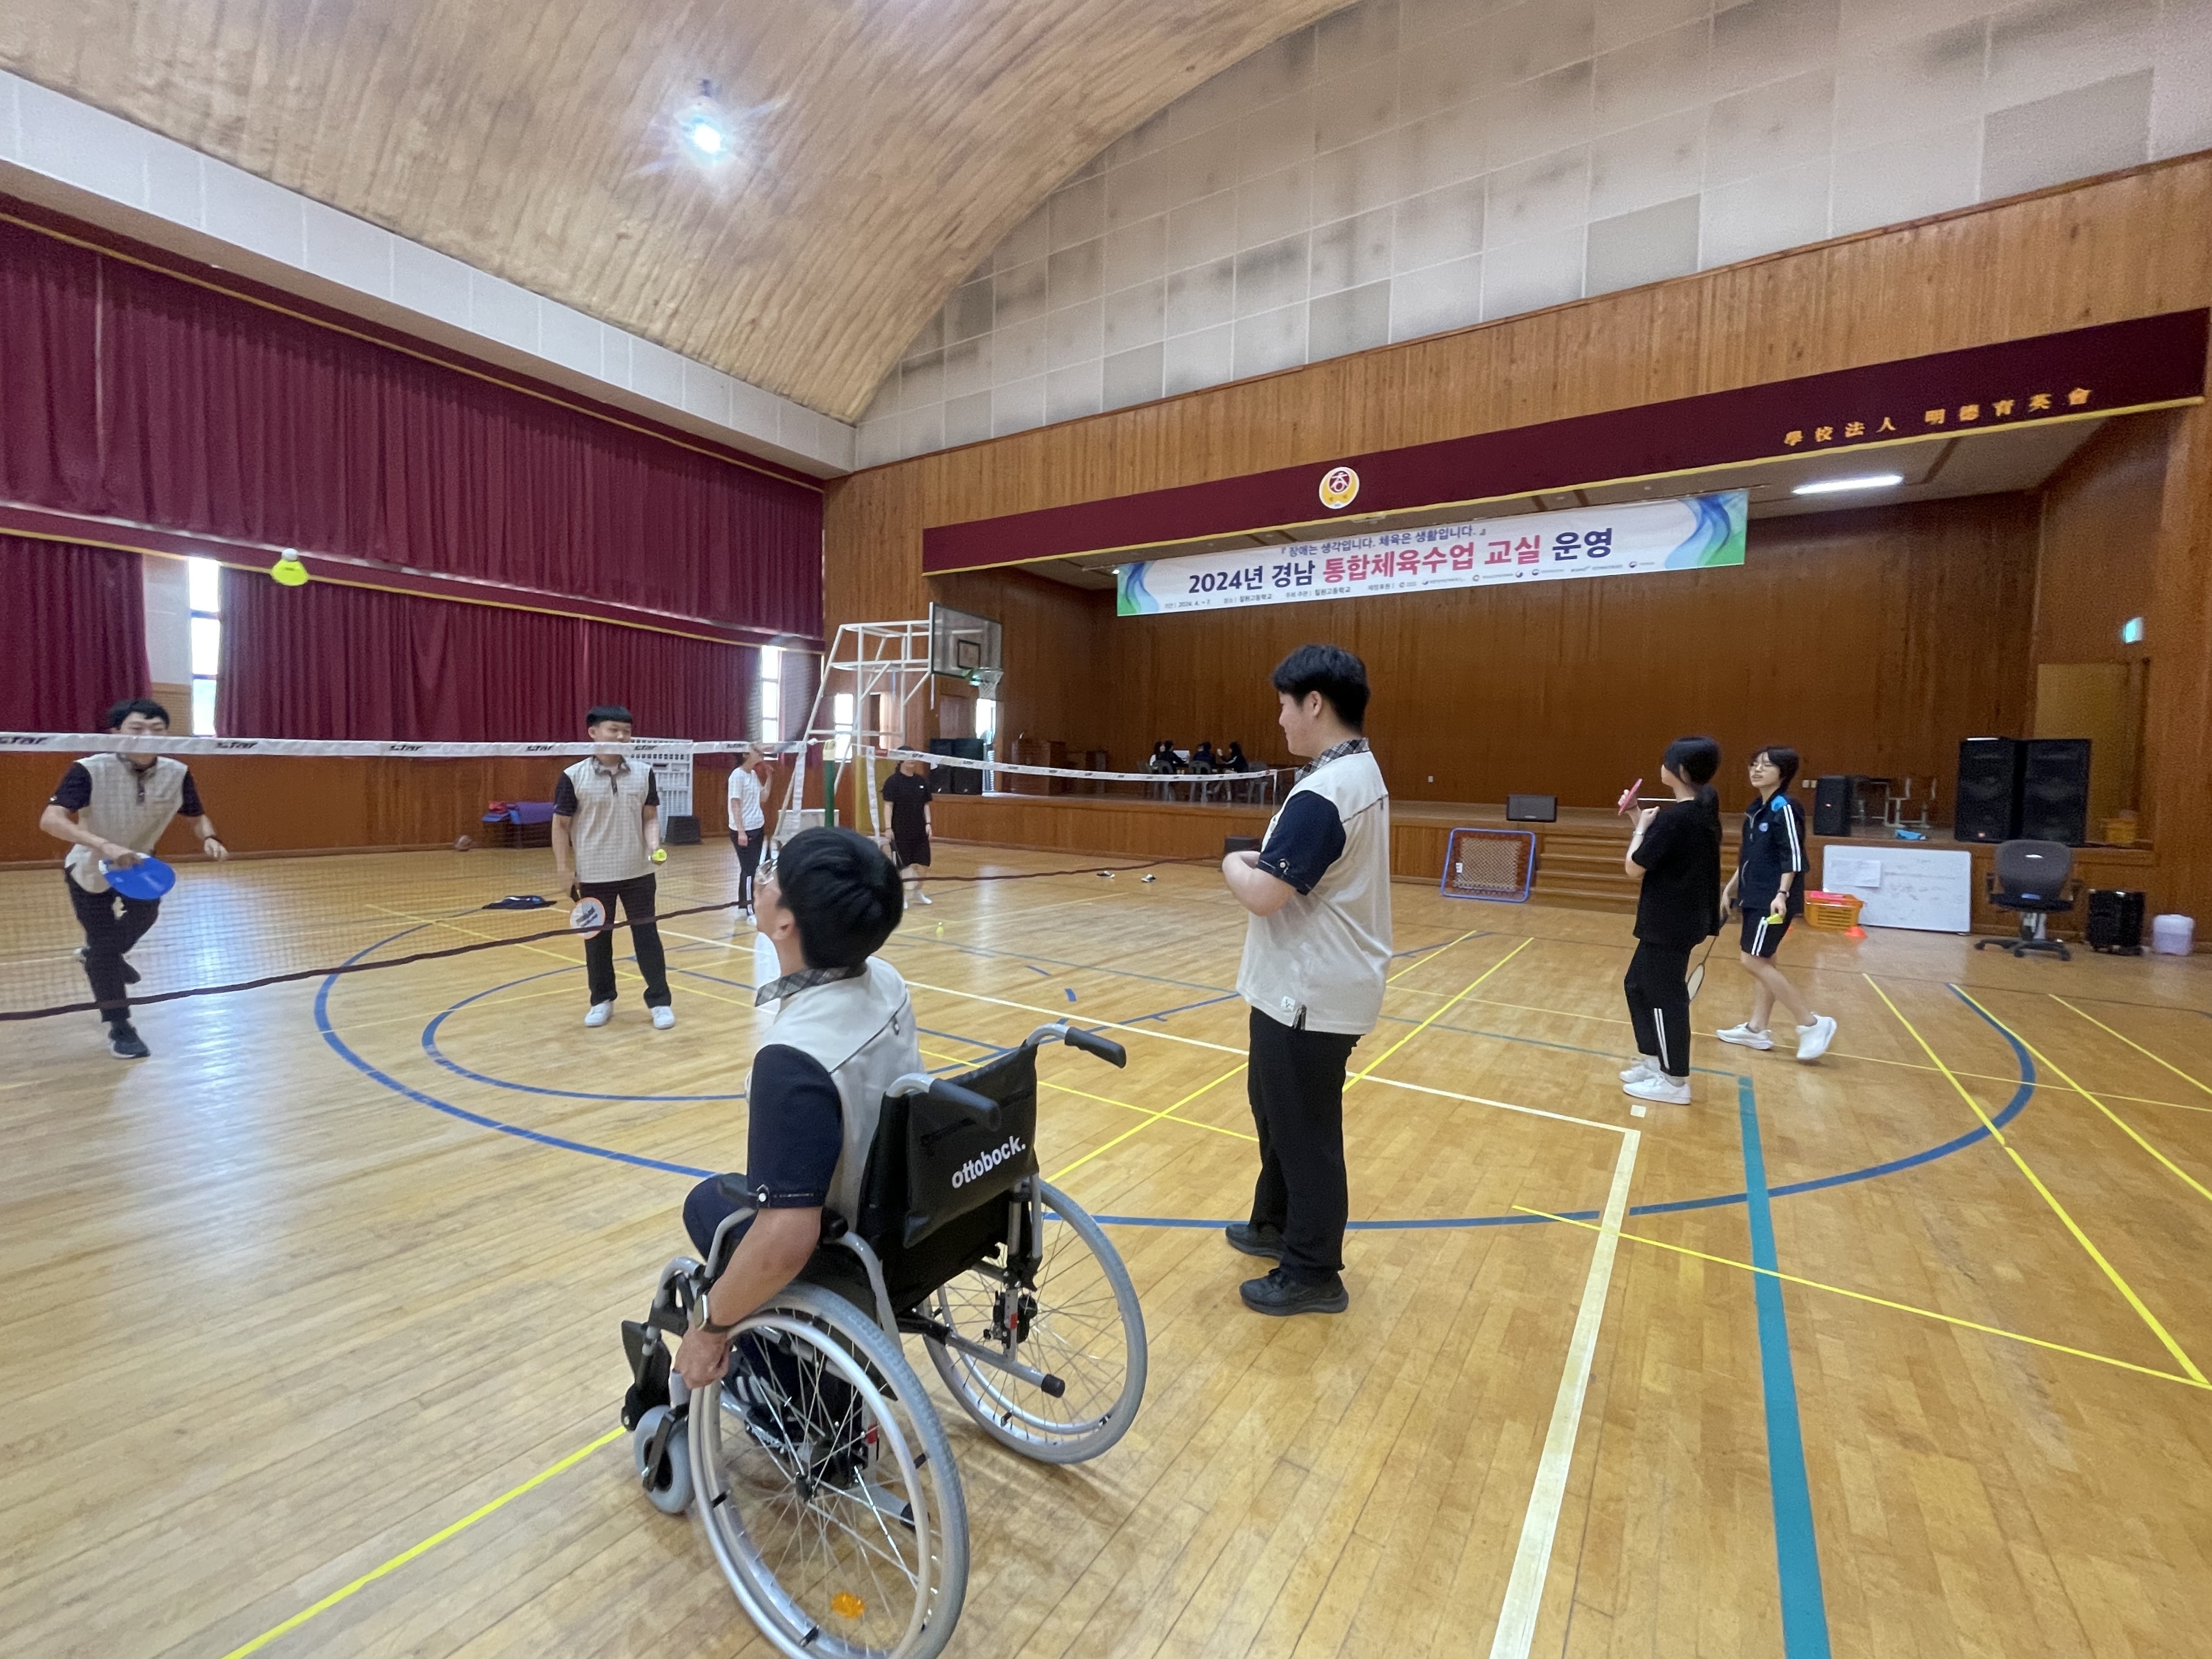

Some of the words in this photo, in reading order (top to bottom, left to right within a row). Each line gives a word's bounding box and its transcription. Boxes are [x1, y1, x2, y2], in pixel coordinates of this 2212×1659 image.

[1188, 565, 1263, 594] 2024년
[1271, 560, 1316, 588] 경남
[1322, 541, 1474, 584] 통합체육수업
[1484, 535, 1541, 566] 교실
[1552, 528, 1613, 562] 운영
[1378, 533, 1412, 546] 체육은
[952, 1135, 1026, 1189] ottobock.
